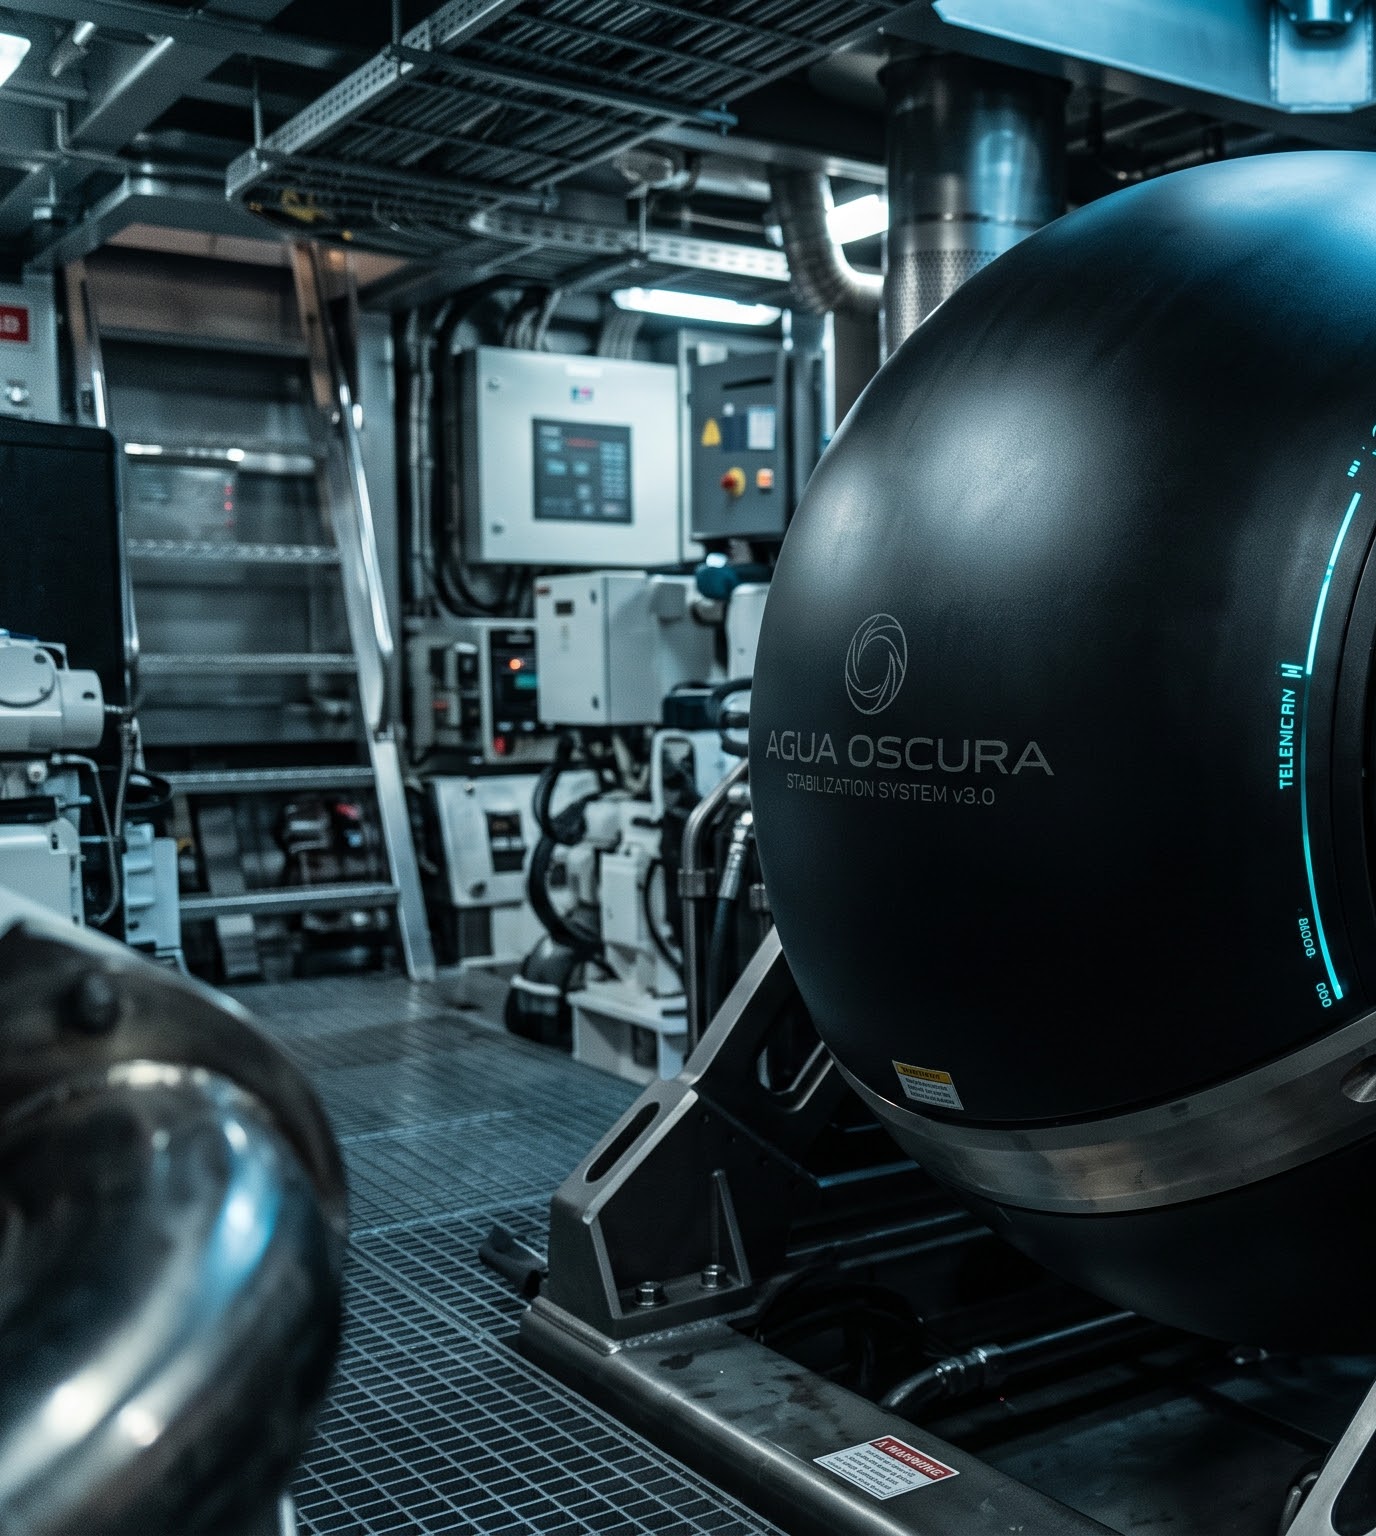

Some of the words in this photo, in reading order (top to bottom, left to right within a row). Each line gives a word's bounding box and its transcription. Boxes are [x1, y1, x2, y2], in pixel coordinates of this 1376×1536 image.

[765, 729, 838, 765] AGUA
[848, 734, 1055, 776] OSCURA
[786, 772, 874, 798] STABILIZATION
[878, 782, 947, 803] SYSTEM
[952, 787, 995, 806] v3.0
